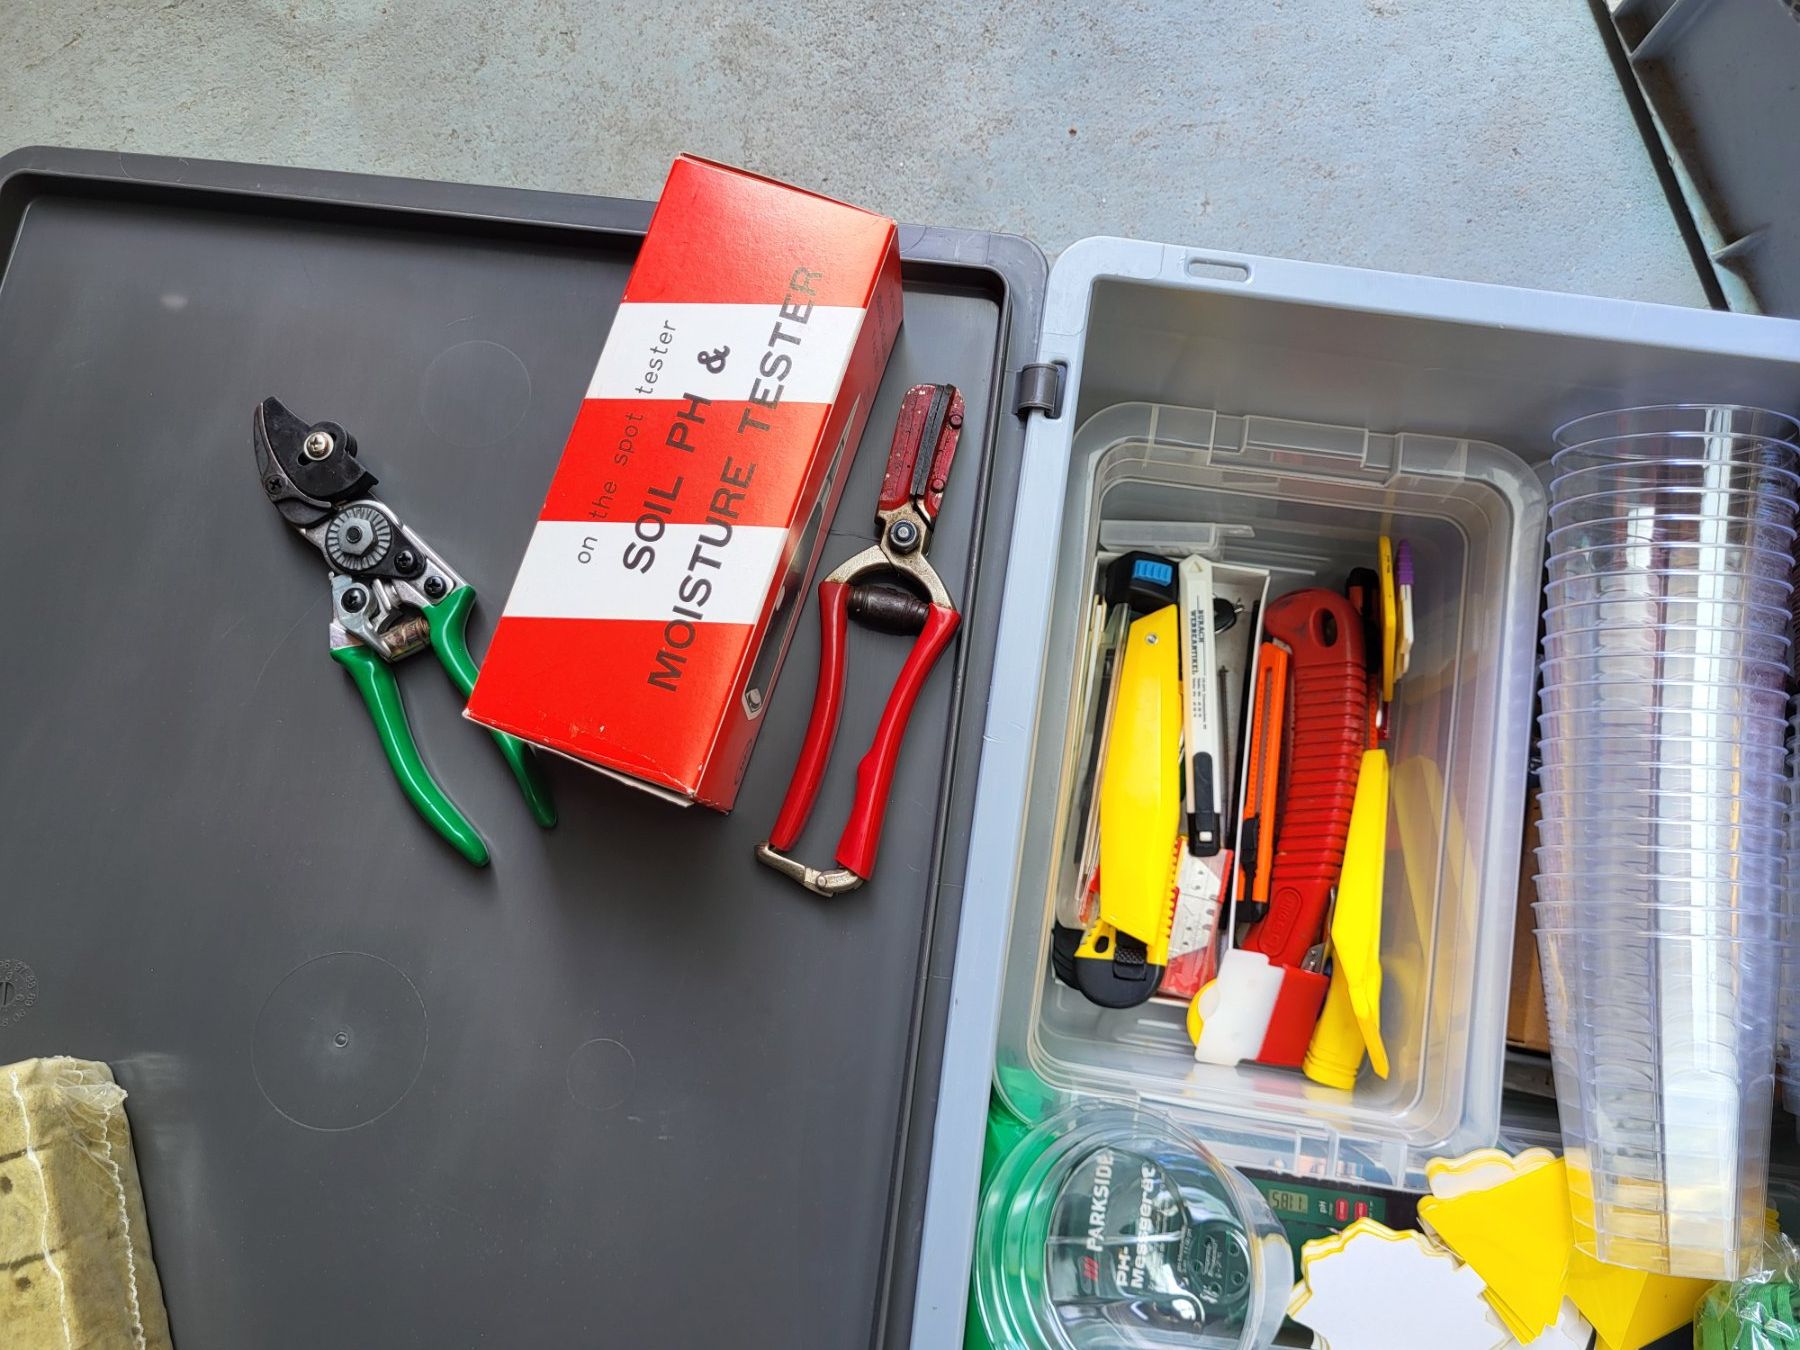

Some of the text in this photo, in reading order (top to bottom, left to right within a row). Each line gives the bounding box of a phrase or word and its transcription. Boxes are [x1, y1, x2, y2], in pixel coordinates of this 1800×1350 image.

[577, 320, 677, 564] on the spot tester
[623, 345, 731, 574] SOIL PH &
[647, 267, 824, 693] MOISTURE TESTER
[1086, 1154, 1115, 1253] PARKSIDE
